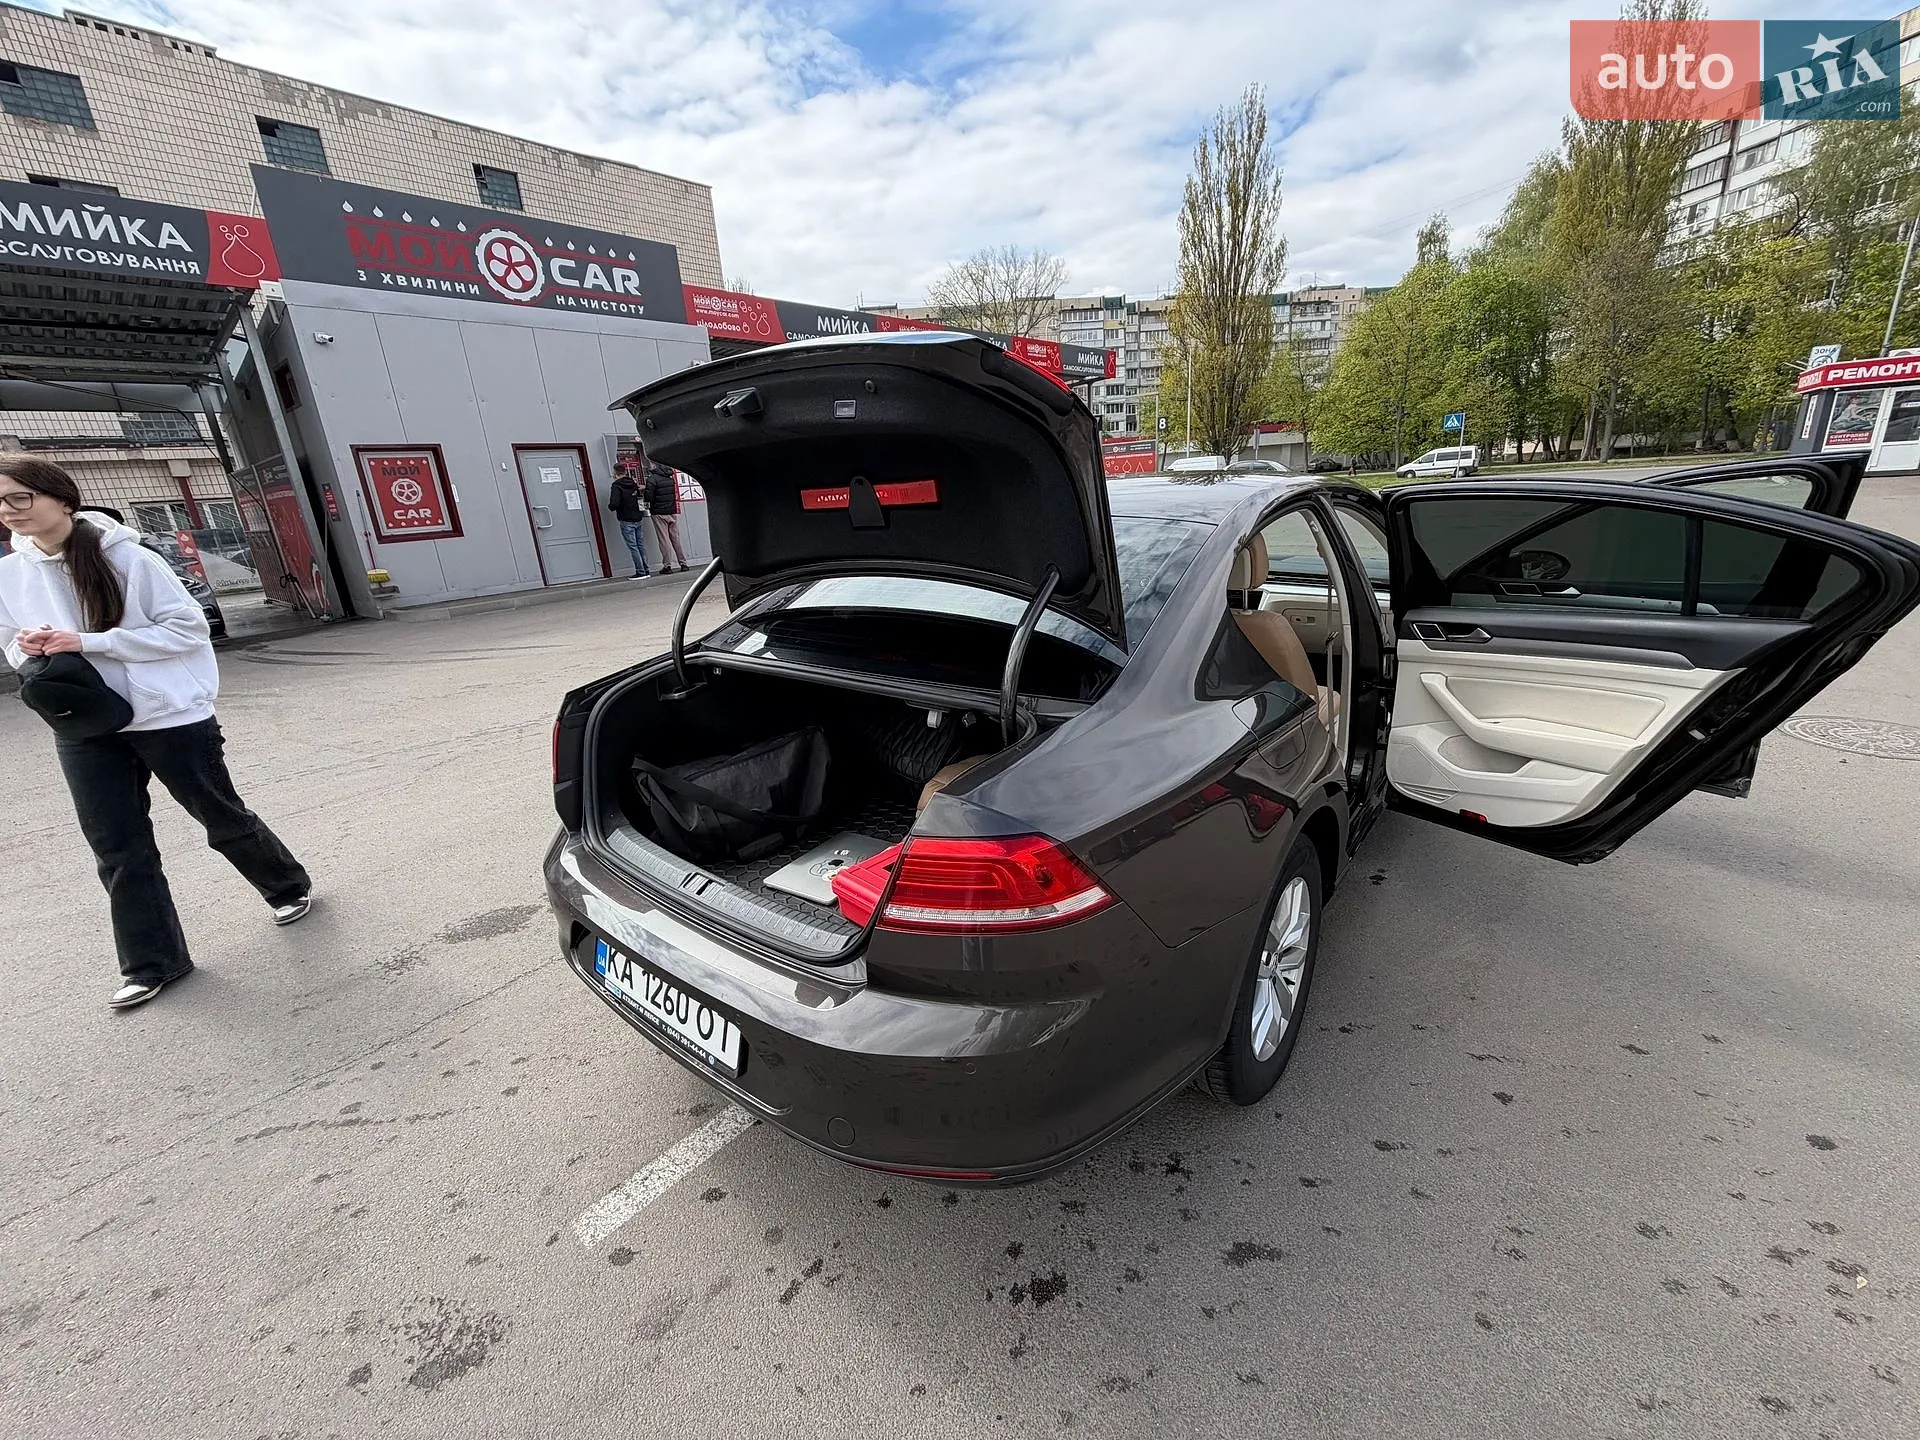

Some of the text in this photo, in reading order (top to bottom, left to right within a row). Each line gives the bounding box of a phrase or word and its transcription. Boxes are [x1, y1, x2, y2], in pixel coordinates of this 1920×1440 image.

[0, 200, 194, 252] МИЙКА
[549, 257, 642, 296] CAR
[380, 272, 480, 295] ХВИЛИНИ
[556, 295, 576, 307] НА
[579, 297, 645, 315] ЧИСТОТУ
[817, 314, 870, 335] МИЙКА
[1077, 351, 1105, 366] МИЙКА
[1159, 418, 1167, 429] 8
[393, 508, 432, 520] CAR
[608, 946, 634, 990] KA
[641, 969, 690, 1025] 1260
